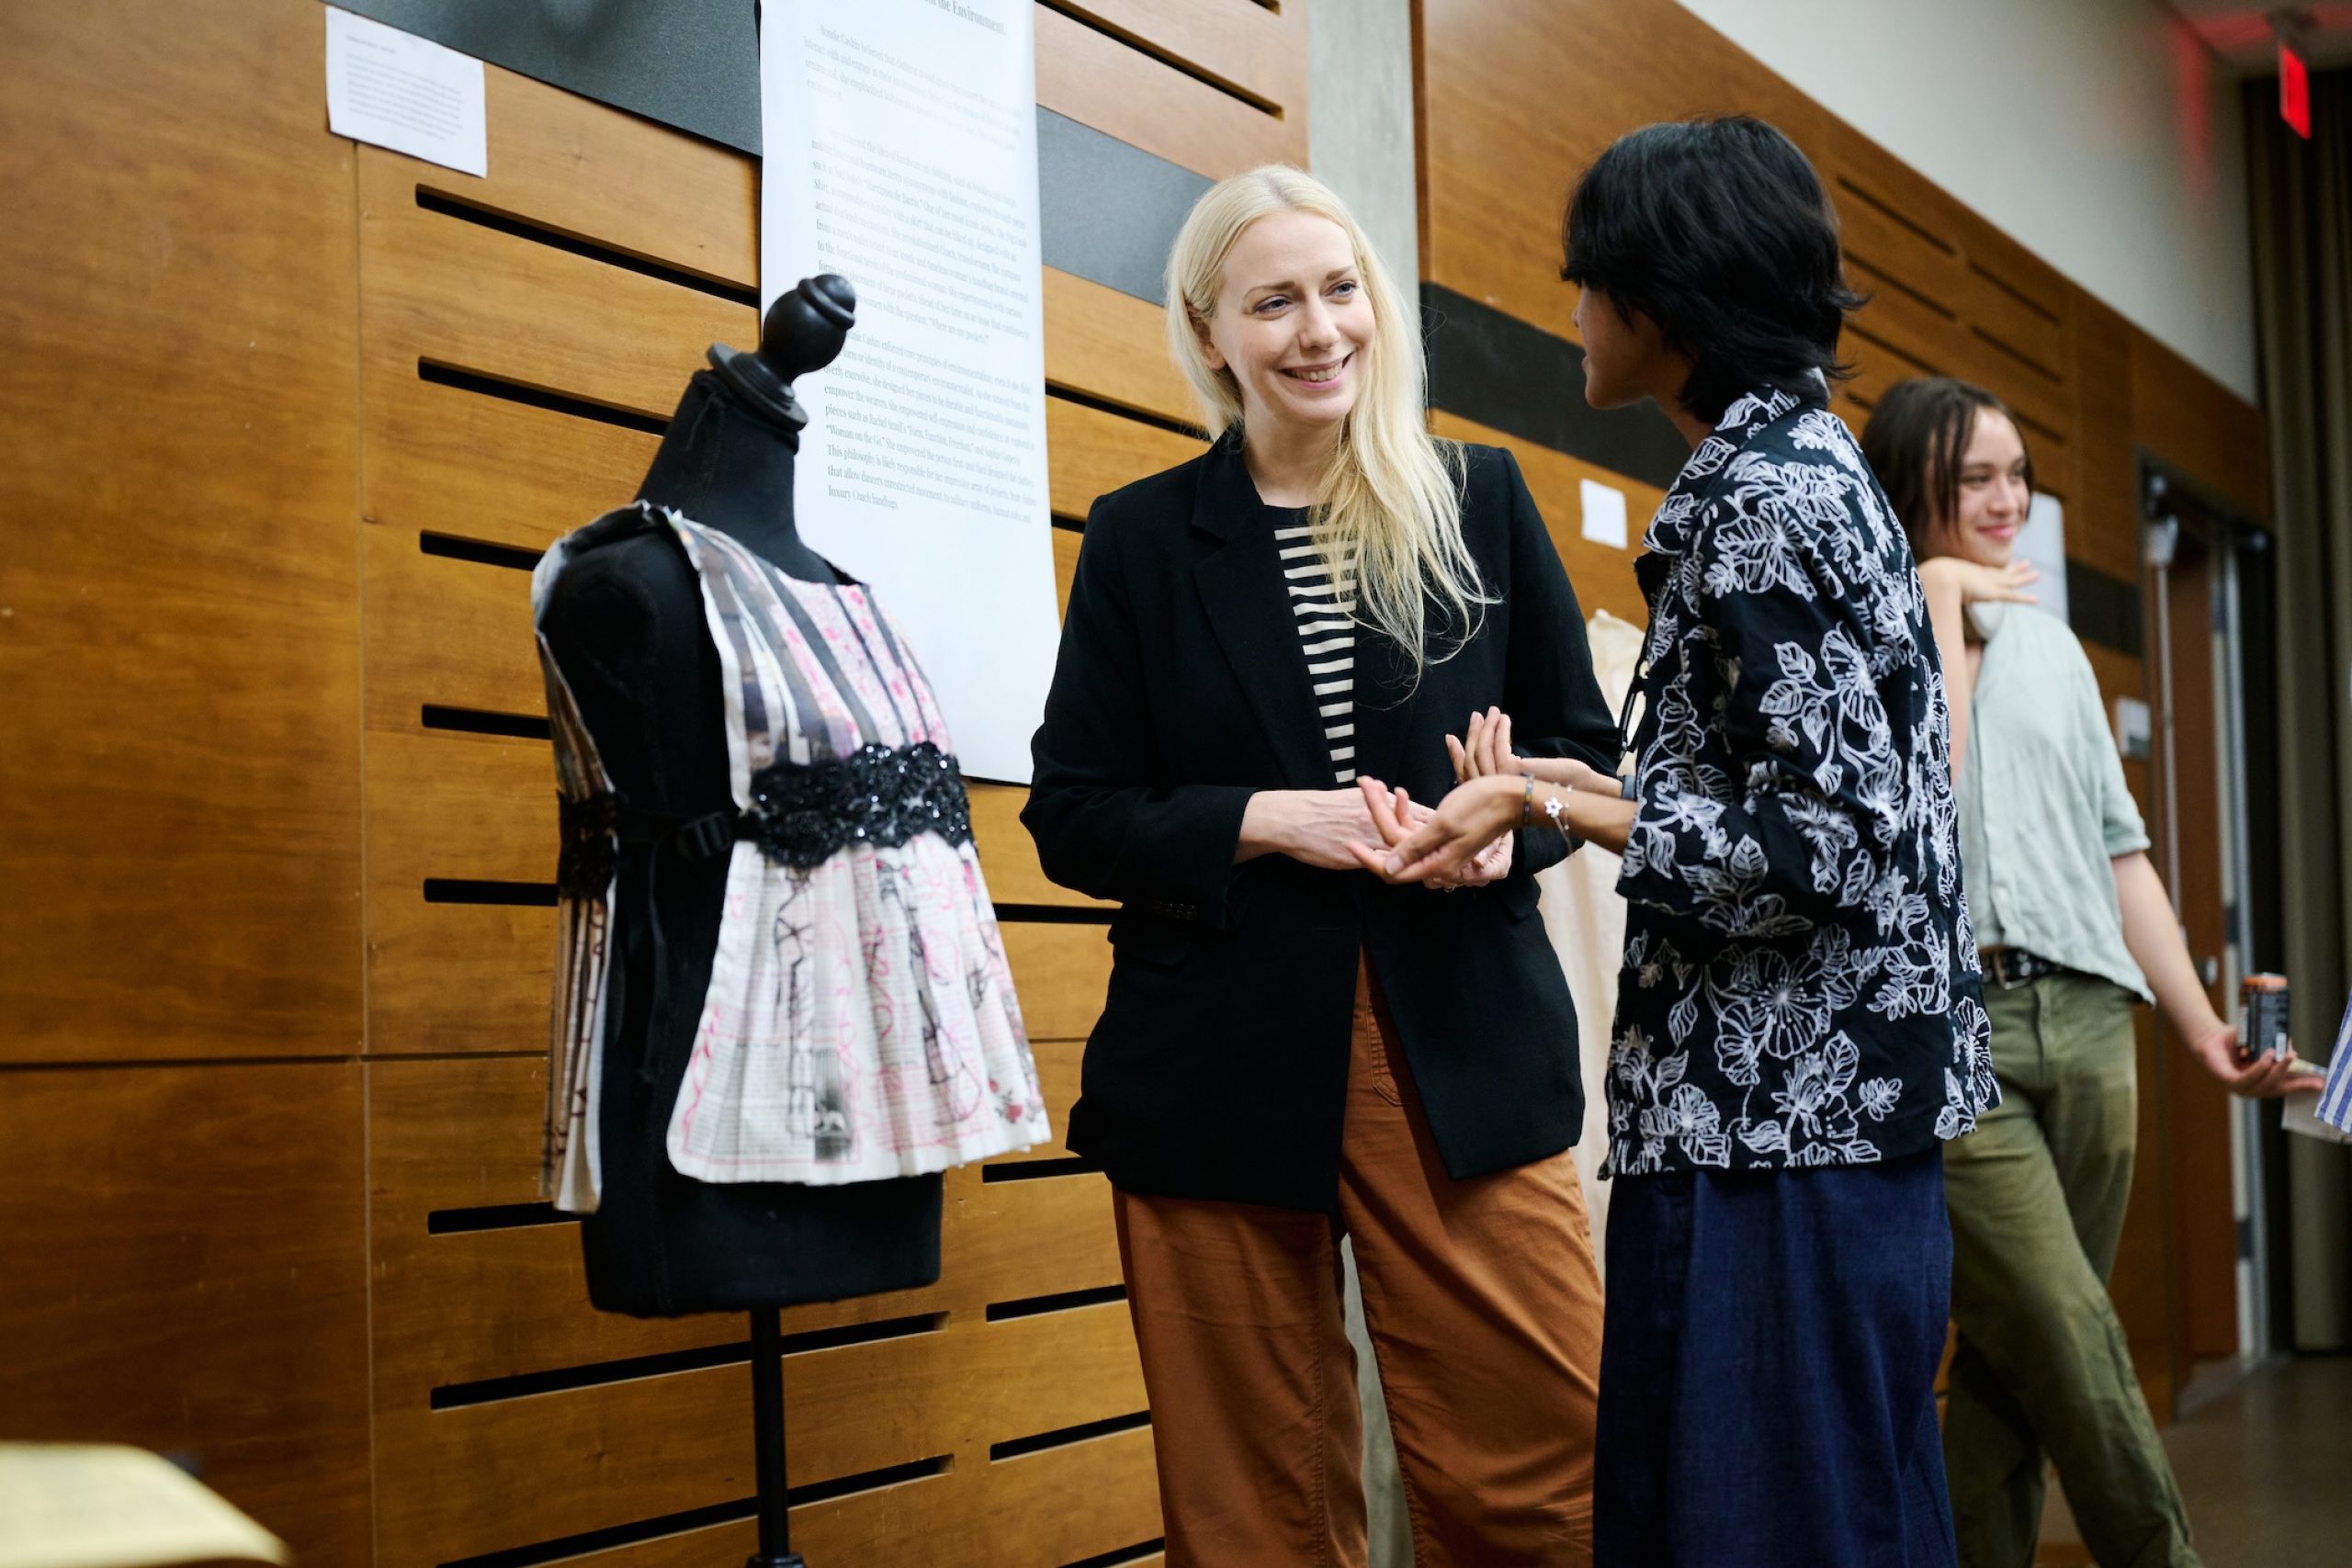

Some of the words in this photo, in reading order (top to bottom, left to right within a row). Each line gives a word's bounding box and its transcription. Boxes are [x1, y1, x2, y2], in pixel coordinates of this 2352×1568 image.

[937, 0, 951, 12] the
[953, 0, 1007, 36] Environment.
[817, 239, 824, 250] to
[824, 383, 853, 399] empower
[854, 389, 864, 401] the
[825, 403, 846, 417] pieces
[847, 410, 861, 421] such
[862, 414, 868, 423] as
[854, 432, 863, 441] on
[864, 432, 872, 443] the
[827, 443, 842, 456] This
[843, 447, 875, 466] philosophy
[876, 456, 881, 466] is
[827, 463, 842, 476] that
[843, 468, 860, 480] allow
[861, 470, 883, 486] dancers
[884, 479, 915, 493] unrestricted
[829, 484, 851, 501] luxury
[852, 489, 871, 502] Coach
